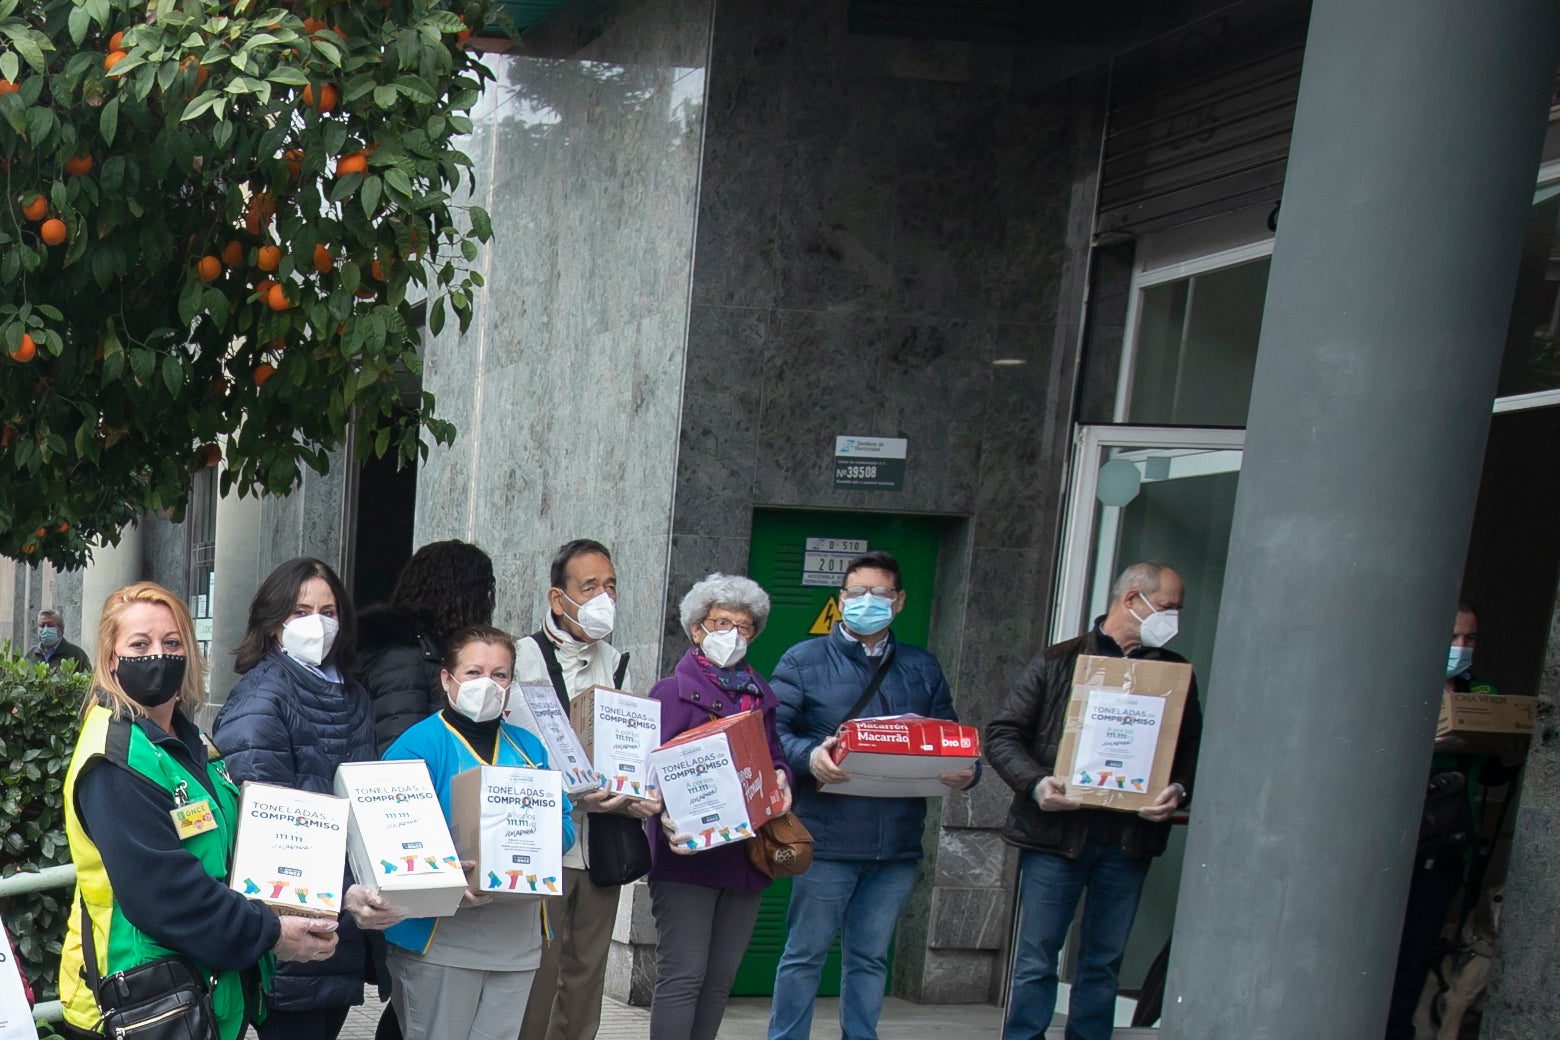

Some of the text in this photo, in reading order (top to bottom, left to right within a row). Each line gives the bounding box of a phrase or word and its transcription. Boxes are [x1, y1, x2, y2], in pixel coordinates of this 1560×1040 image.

[600, 705, 647, 721] TONELADAS
[1093, 706, 1146, 718] TONELADAS
[600, 714, 656, 730] COMPROMISO
[1091, 714, 1155, 726] COMPROMISO
[858, 732, 909, 743] Macarrão
[662, 753, 716, 774] TONELADAS
[664, 759, 729, 782] COMPROMISO
[355, 785, 419, 795] TONELADAS
[488, 786, 544, 798] TONELADAS
[357, 792, 433, 803] COMPROMISO
[487, 796, 556, 808] COMPROMISO
[185, 805, 205, 817] ONCE
[252, 802, 326, 820] TONELADAS
[251, 811, 340, 831] COMPROMISO
